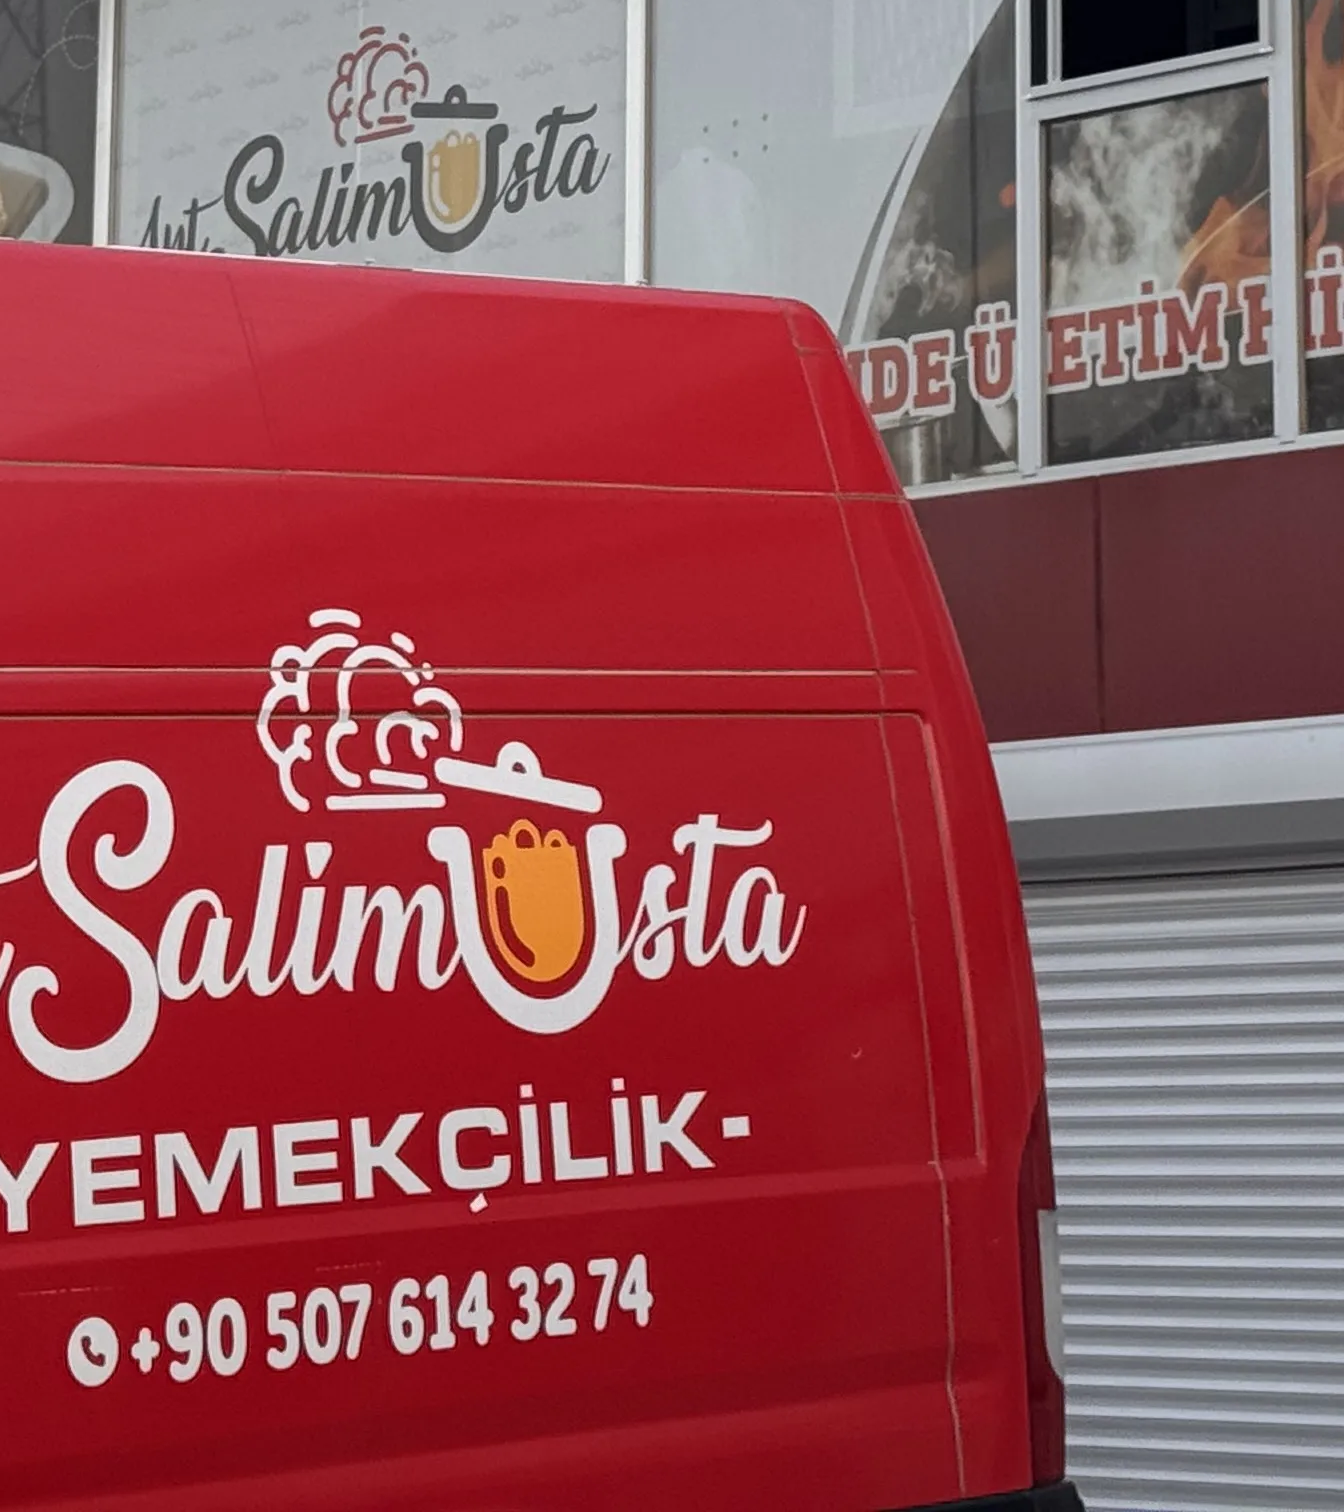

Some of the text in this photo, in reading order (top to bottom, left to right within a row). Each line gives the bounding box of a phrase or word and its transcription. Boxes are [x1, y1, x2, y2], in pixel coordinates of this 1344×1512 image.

[970, 289, 1224, 400] ÜETİM
[131, 1253, 653, 1383] +90 507 614 32 74
